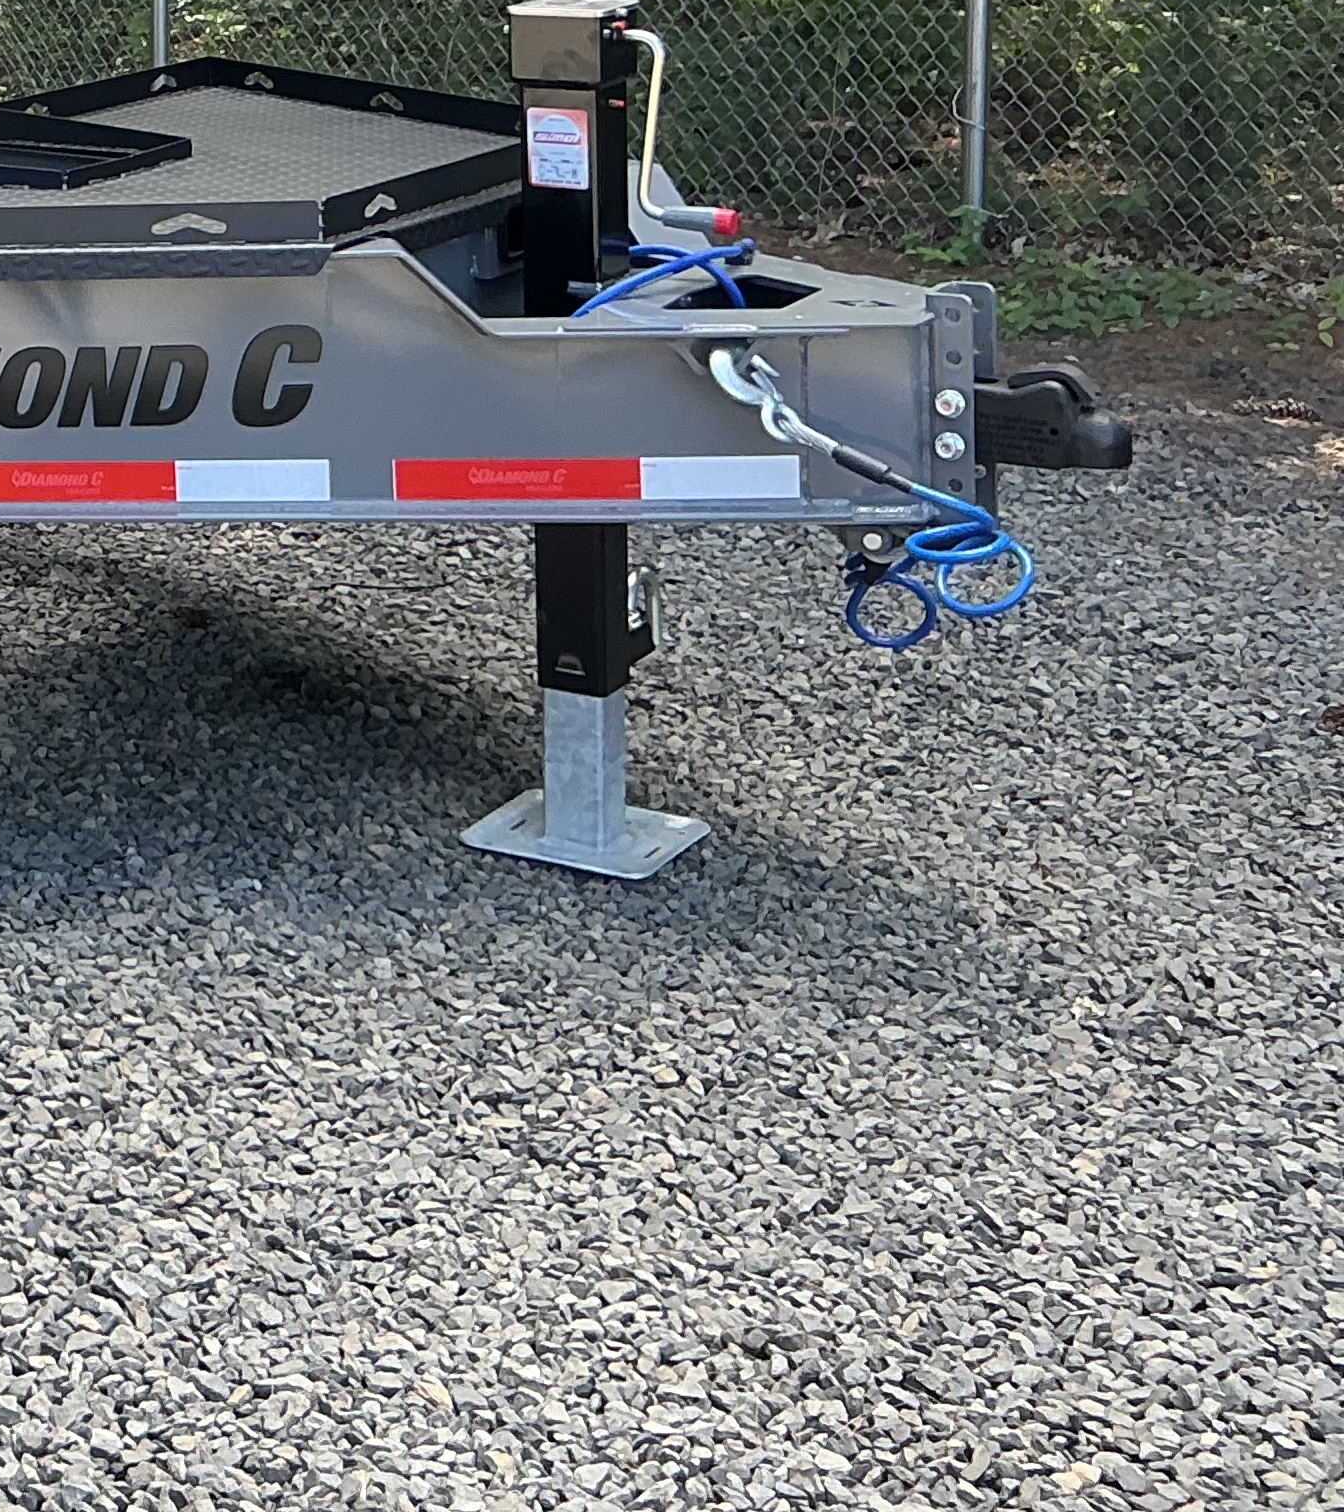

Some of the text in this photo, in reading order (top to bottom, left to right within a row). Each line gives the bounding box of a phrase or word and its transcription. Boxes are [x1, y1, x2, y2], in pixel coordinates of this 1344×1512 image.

[232, 324, 323, 427] C
[20, 471, 104, 486] DIAMOND C
[479, 468, 567, 484] DIAMOND C
